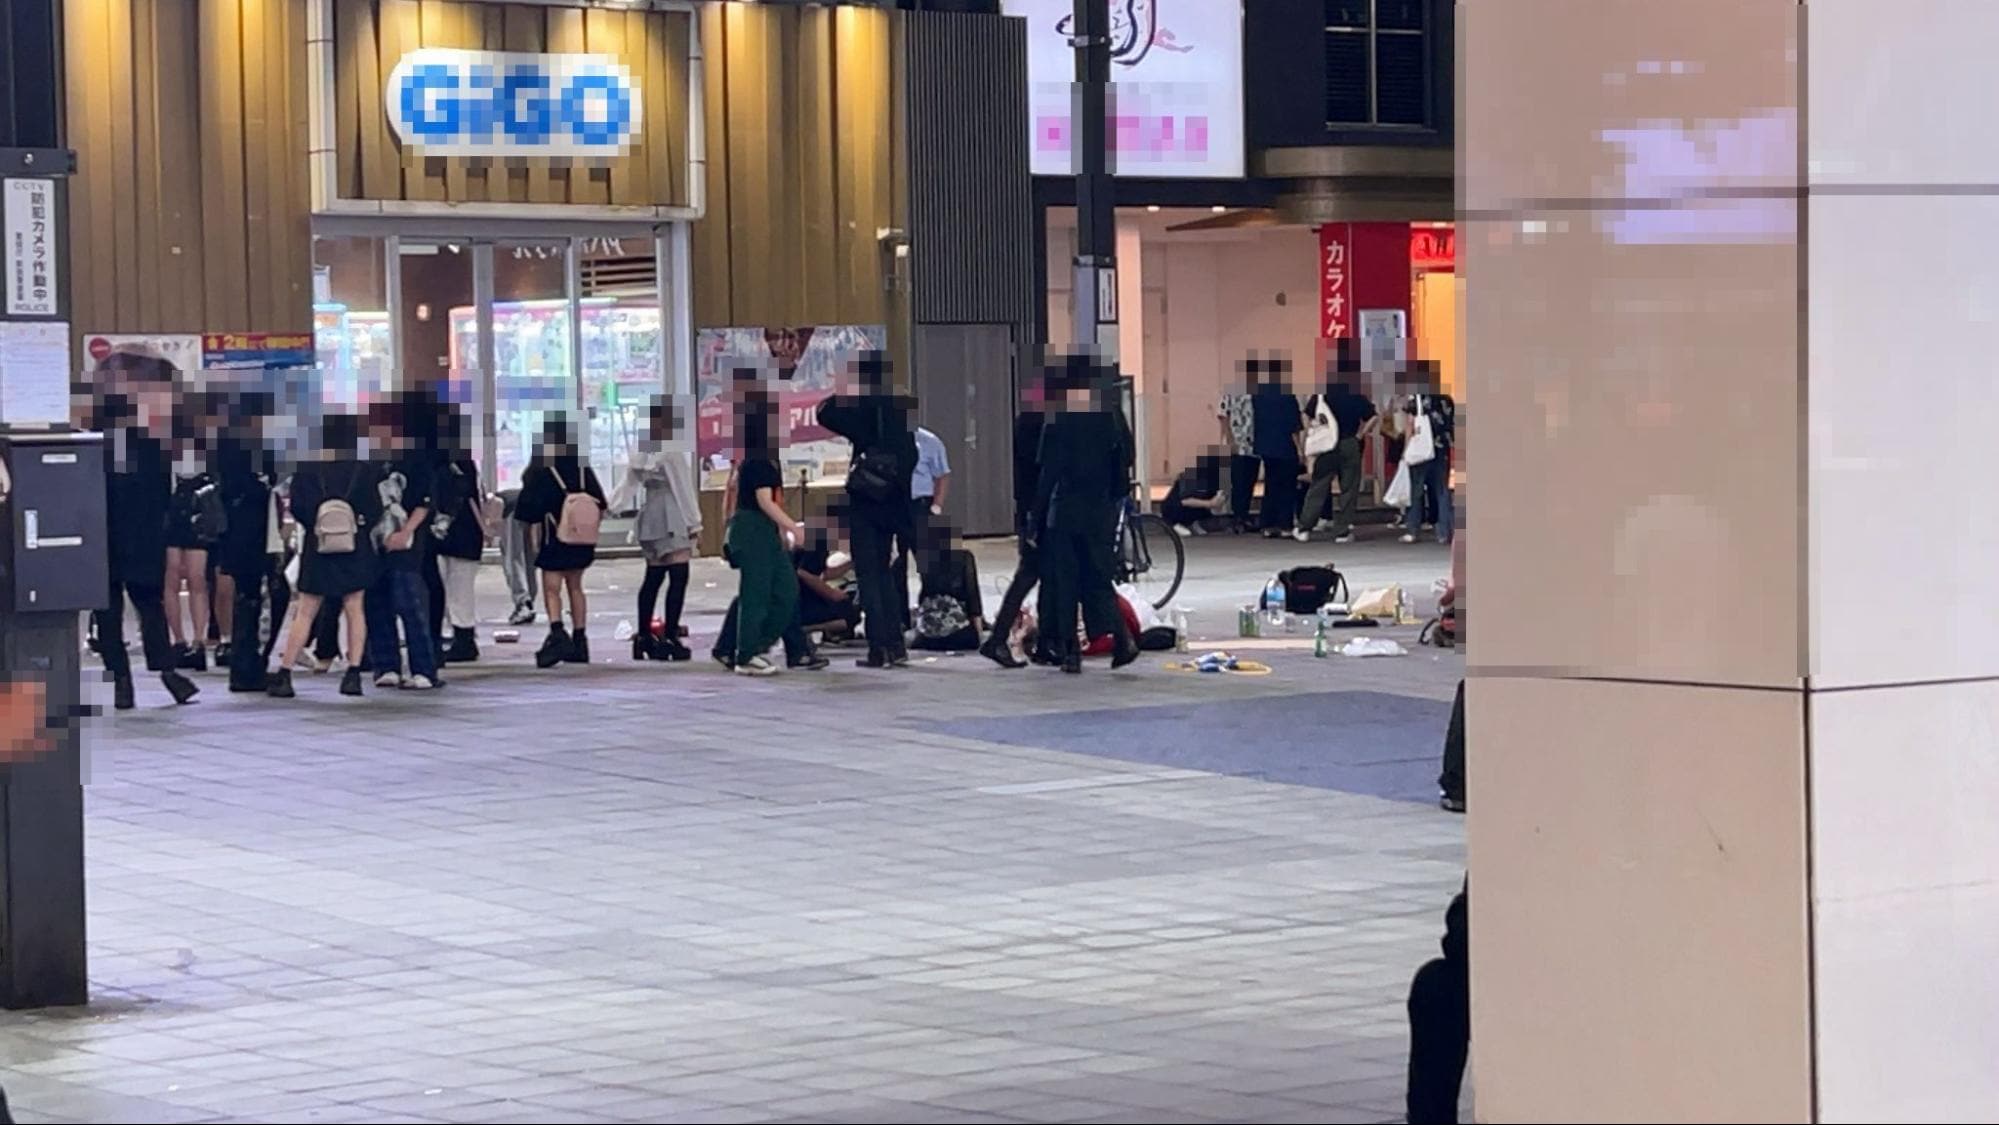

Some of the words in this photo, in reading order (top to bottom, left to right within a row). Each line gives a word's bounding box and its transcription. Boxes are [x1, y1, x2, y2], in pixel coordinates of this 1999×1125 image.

[13, 182, 45, 191] CCTV
[31, 192, 47, 300] 防犯カメラ作動中
[15, 303, 49, 312] POLICE
[1326, 240, 1346, 338] カラオケ
